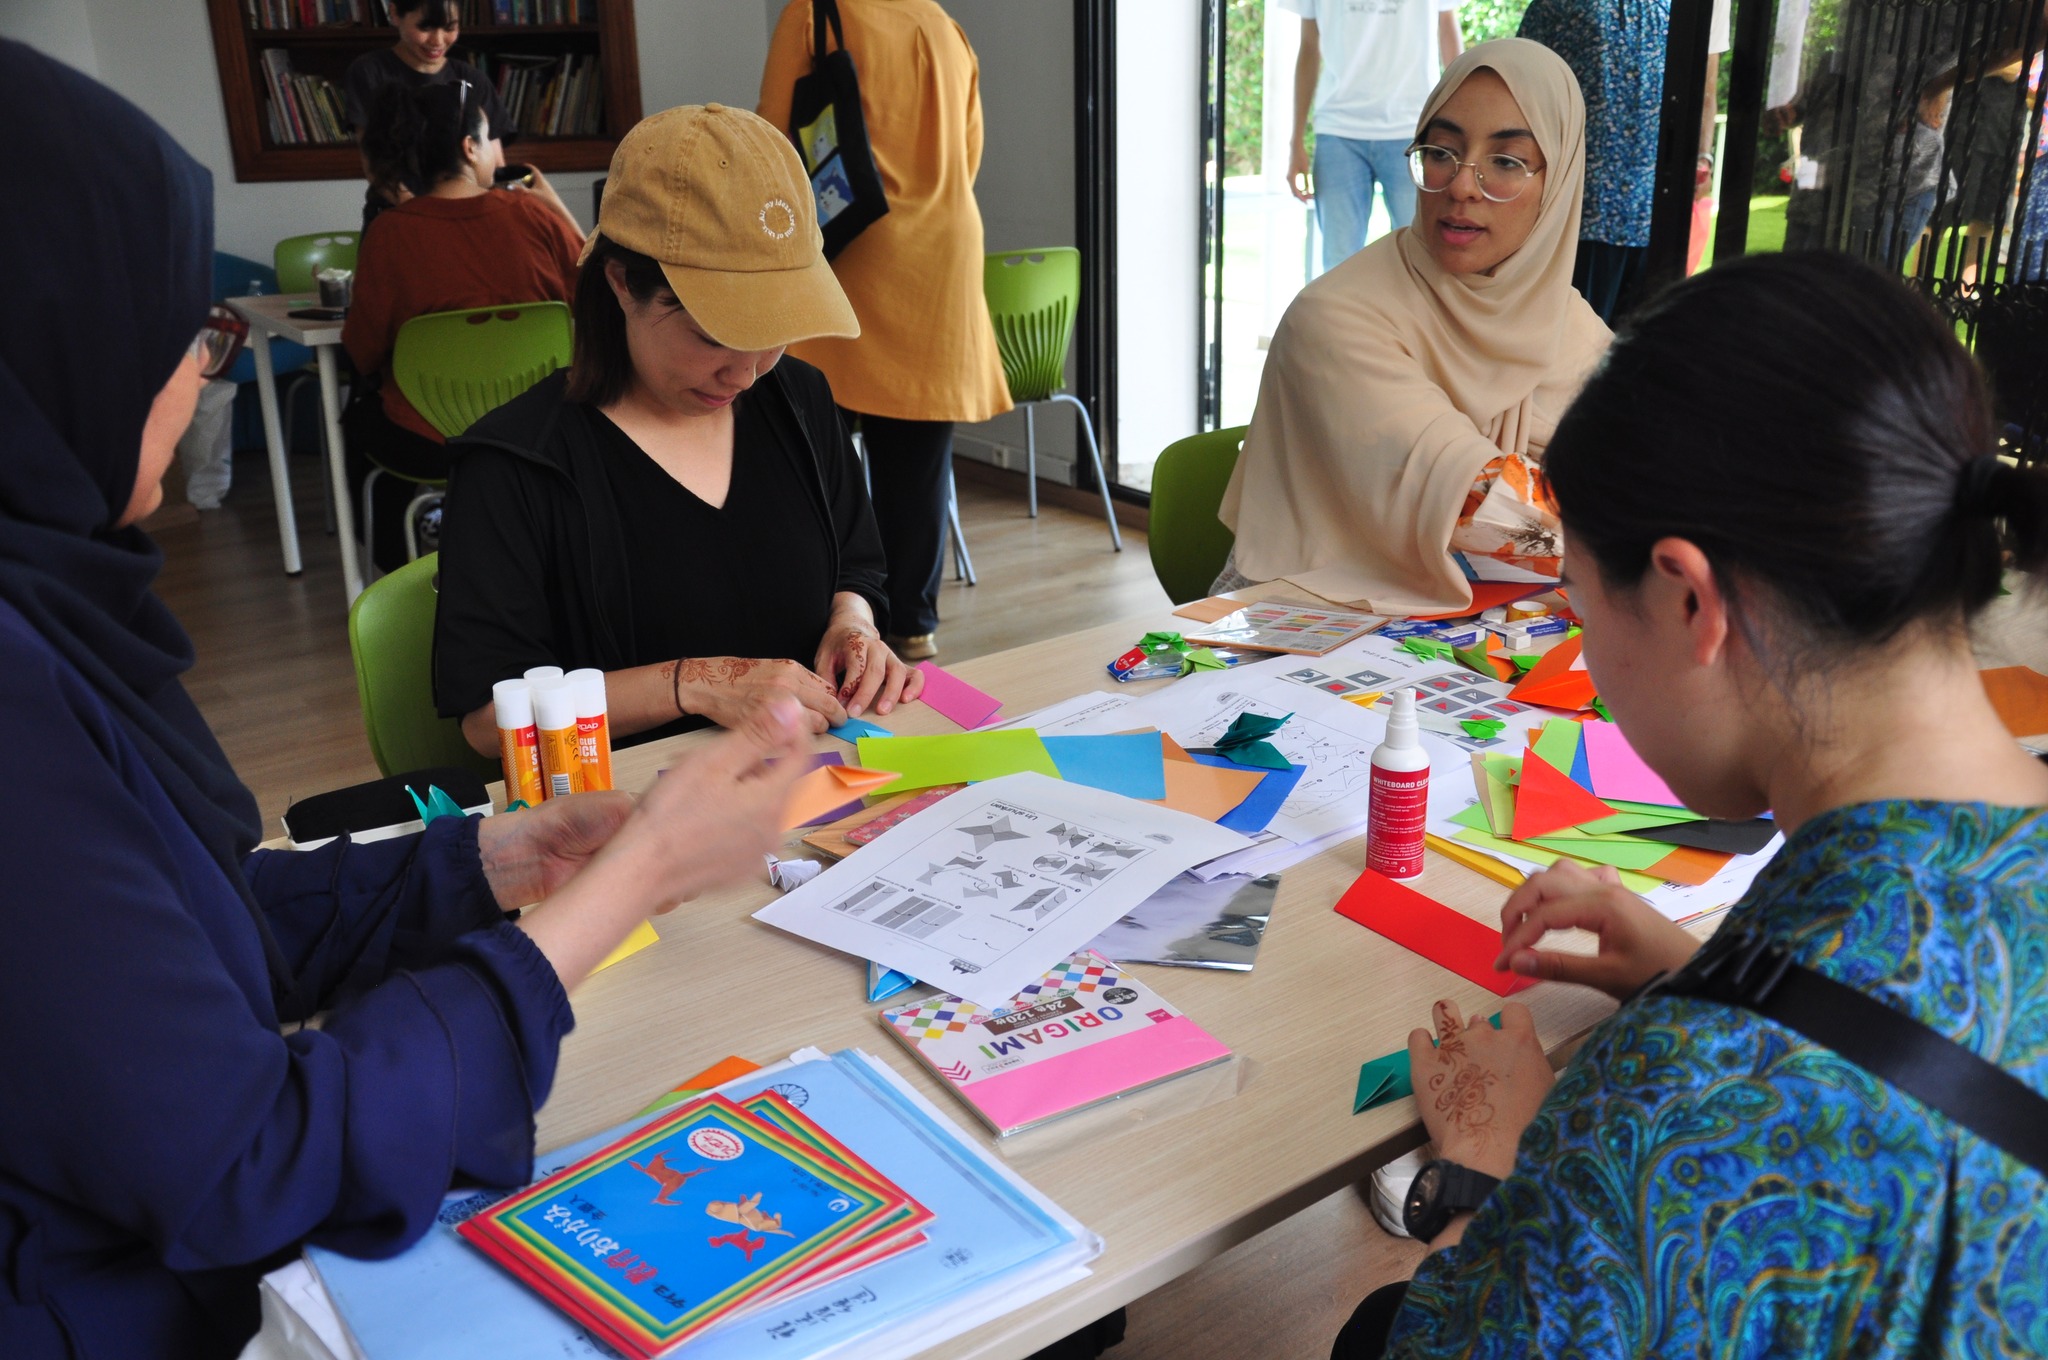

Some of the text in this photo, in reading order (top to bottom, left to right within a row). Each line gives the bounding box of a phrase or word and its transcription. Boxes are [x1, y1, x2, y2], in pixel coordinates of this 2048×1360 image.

[577, 722, 599, 732] ROAD
[580, 745, 598, 757] ICK
[1373, 777, 1415, 788] WHITEBOARD
[978, 1006, 1124, 1060] ORIGAMI
